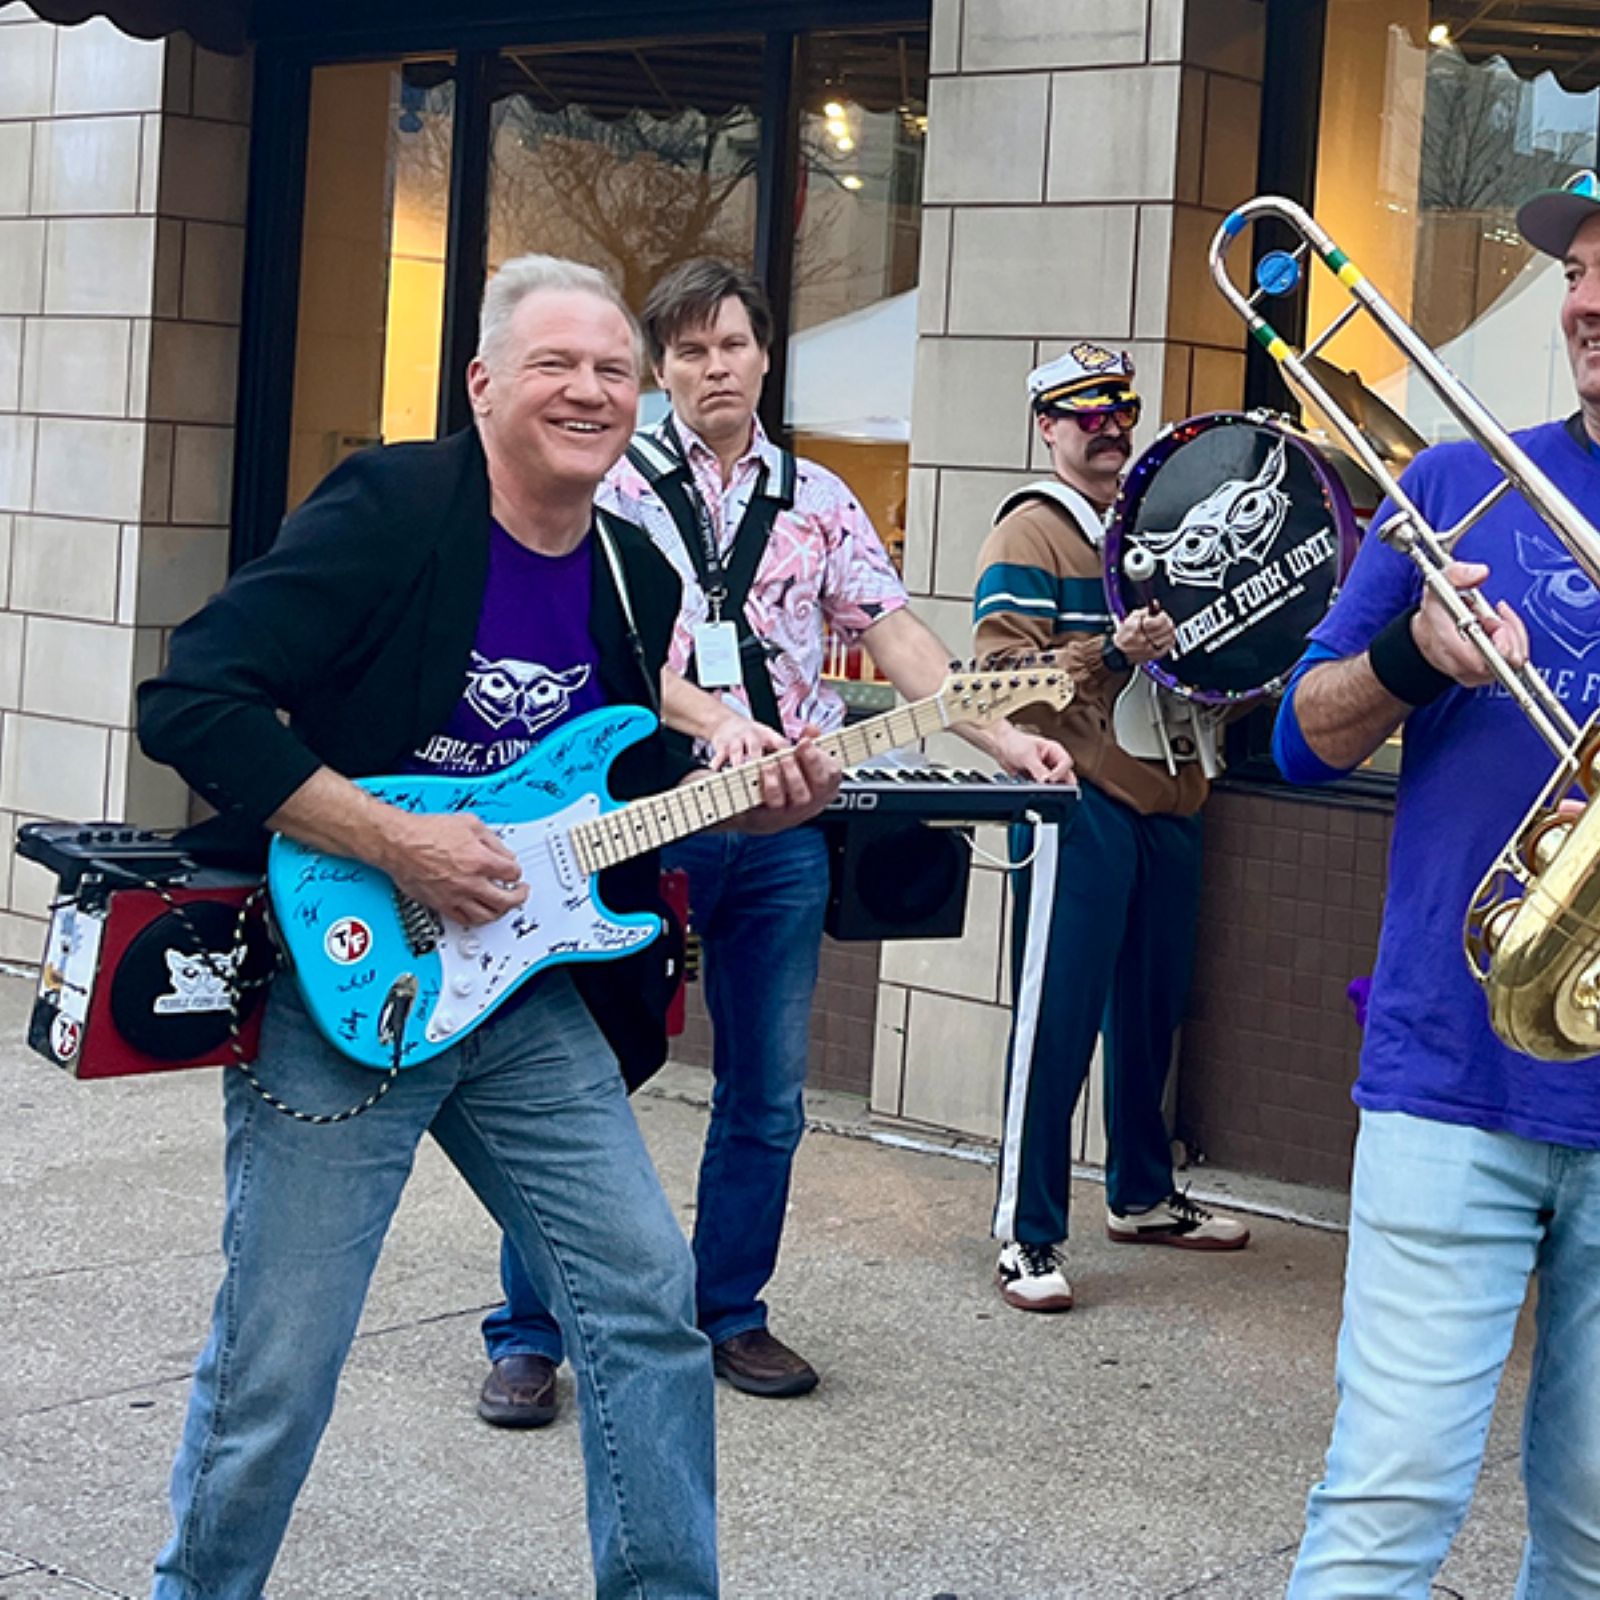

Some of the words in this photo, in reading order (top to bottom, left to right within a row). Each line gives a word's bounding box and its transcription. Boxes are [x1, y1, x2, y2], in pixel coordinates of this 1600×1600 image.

[1230, 560, 1289, 616] FUNK
[1284, 526, 1336, 578] UNIT
[485, 738, 540, 766] FUN
